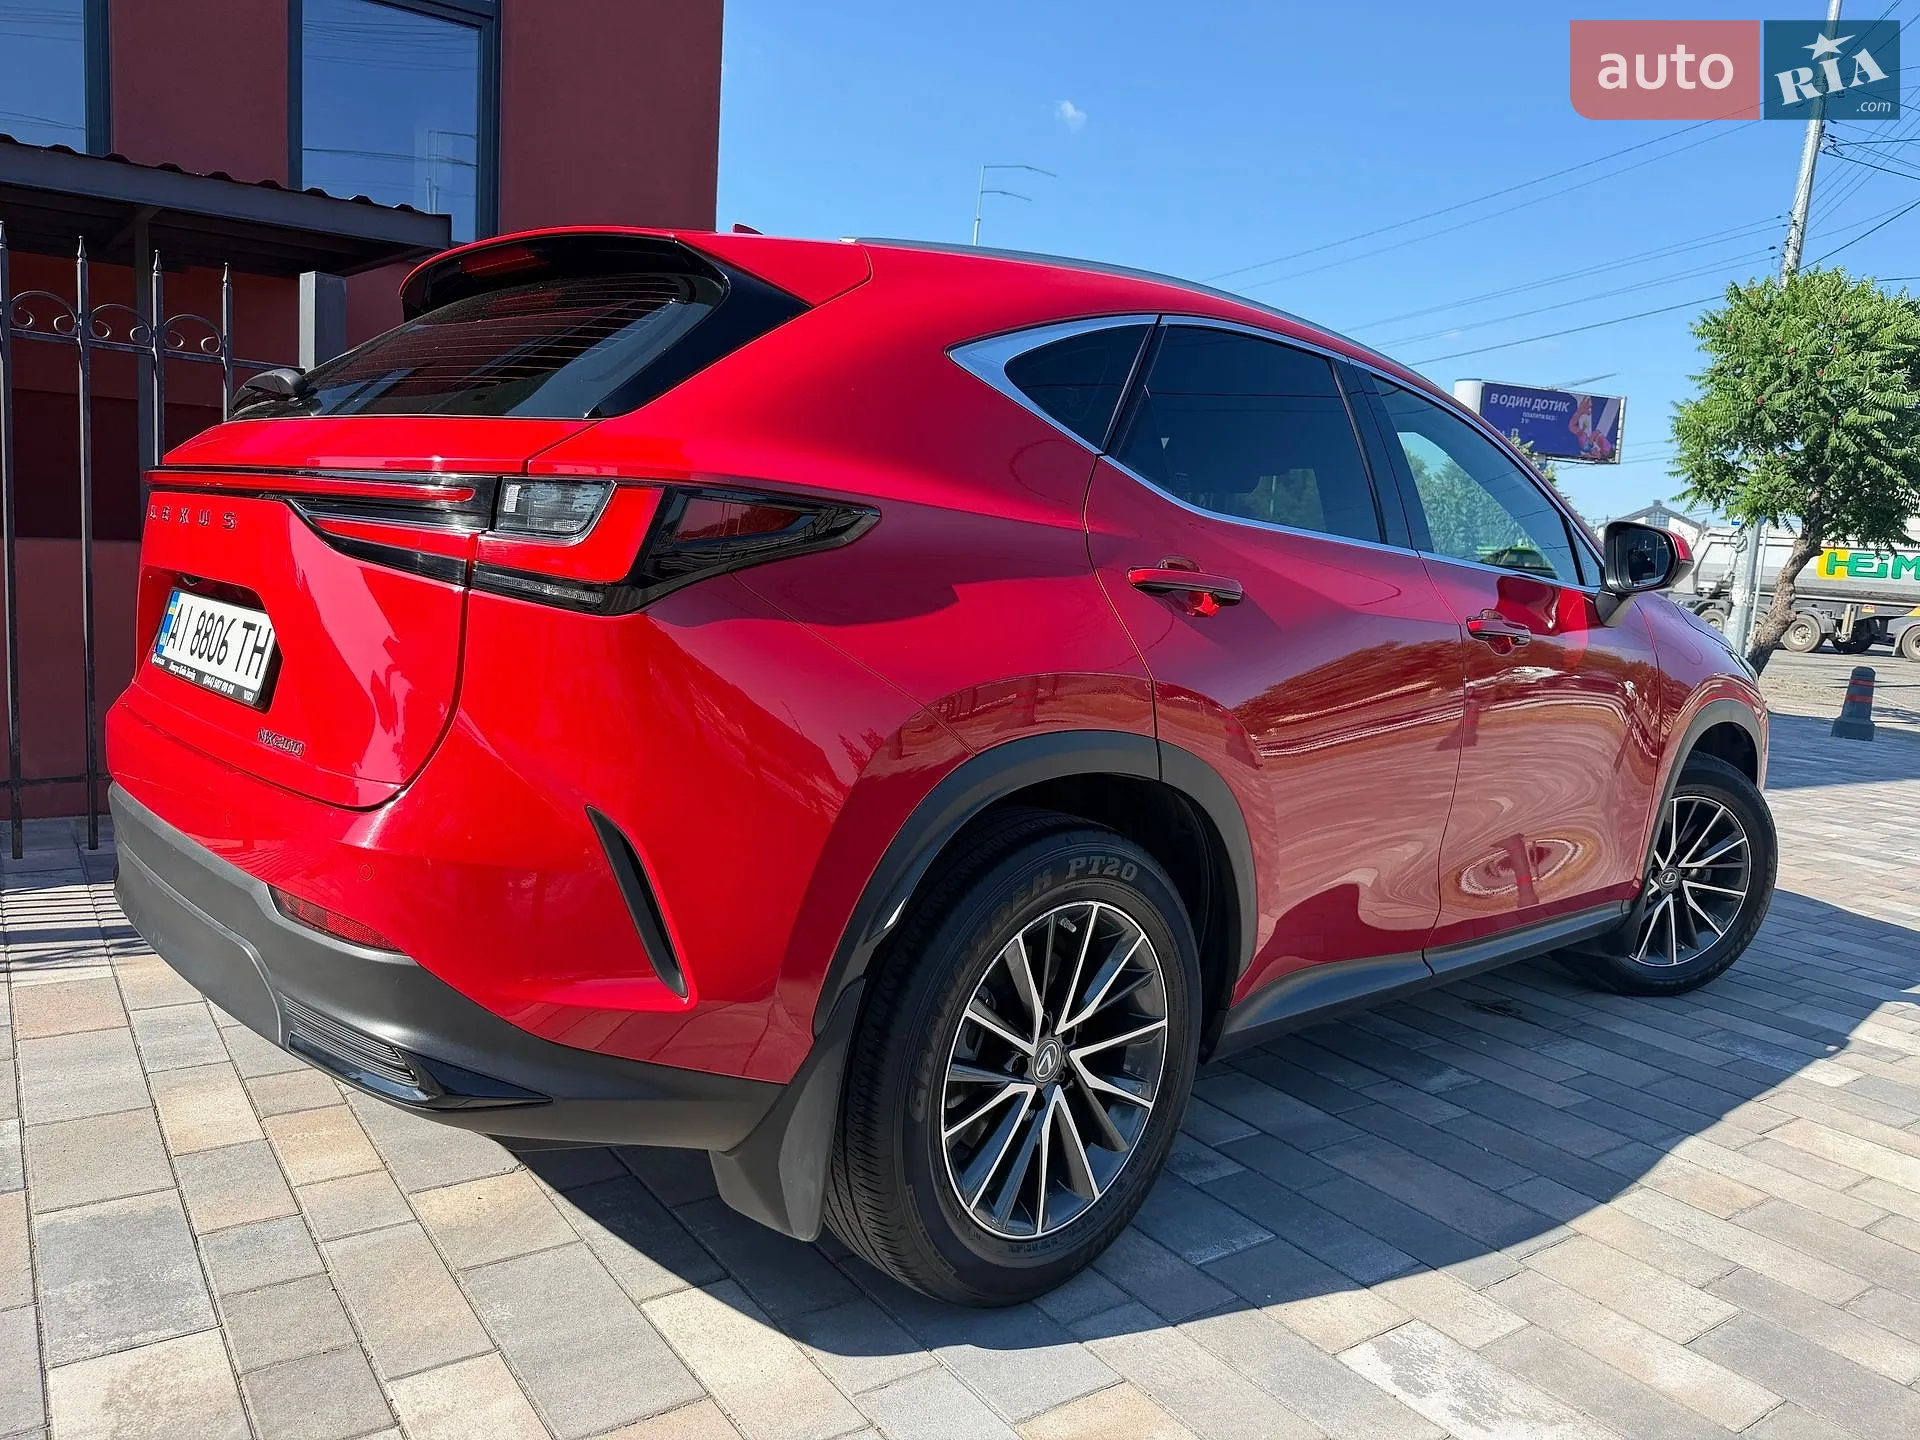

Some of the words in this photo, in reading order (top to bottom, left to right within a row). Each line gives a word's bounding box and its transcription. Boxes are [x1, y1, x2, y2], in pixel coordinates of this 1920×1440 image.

[1490, 393, 1499, 404] В
[1499, 394, 1532, 408] ОДИН
[1532, 398, 1570, 412] ДОТИК
[149, 504, 236, 530] LEXUS
[189, 609, 237, 666] 8806
[234, 620, 272, 680] TH
[1065, 855, 1138, 882] PT20
